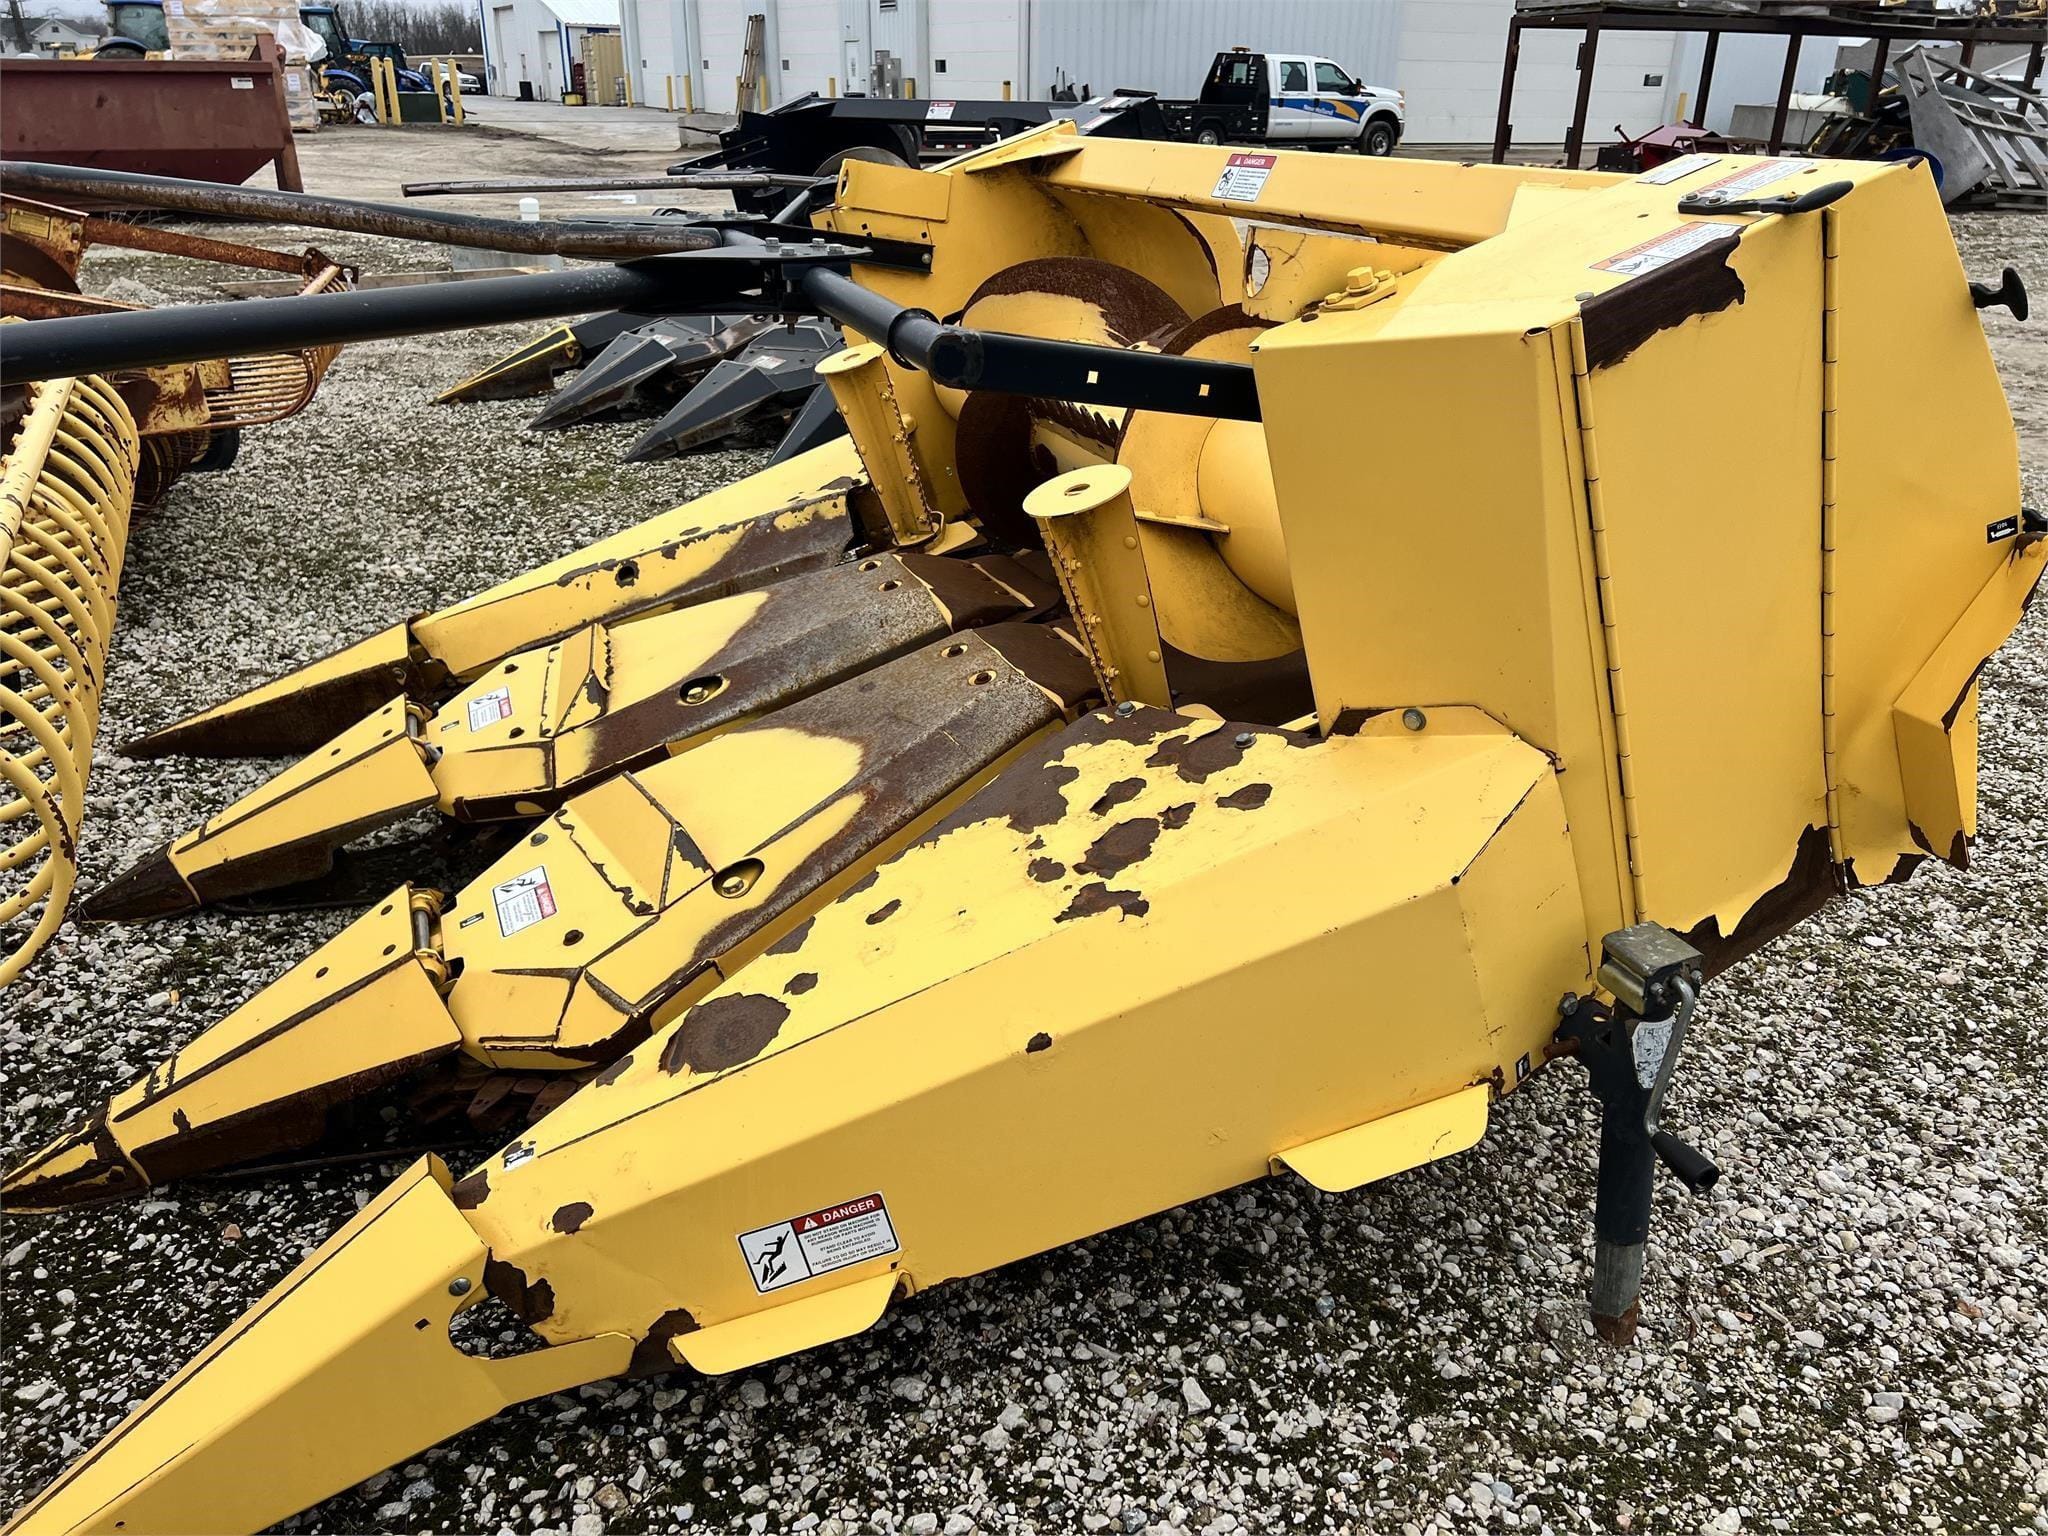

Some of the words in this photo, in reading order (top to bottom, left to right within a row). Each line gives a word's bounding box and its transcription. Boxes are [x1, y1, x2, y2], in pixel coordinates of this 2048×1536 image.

[1243, 158, 1266, 166] DANGER
[1630, 228, 1691, 254] WARNING
[822, 1200, 875, 1223] DANGER
[817, 1230, 837, 1240] REASON
[838, 1225, 852, 1233] WHEN
[853, 1218, 874, 1229] MACHINE
[822, 1225, 839, 1234] STAND
[847, 1216, 869, 1226] MACHINE
[811, 1236, 832, 1246] RUNNING
[841, 1229, 857, 1237] PARTS
[820, 1243, 836, 1252] STAND
[836, 1238, 853, 1246] CLEAR
[861, 1231, 876, 1239] AVOID
[812, 1257, 831, 1266] FAILURE
[866, 1240, 885, 1249] RESULT
[826, 1246, 841, 1254] BEING
[821, 1258, 842, 1268] SERIOUS
[842, 1253, 859, 1261] INJURY
